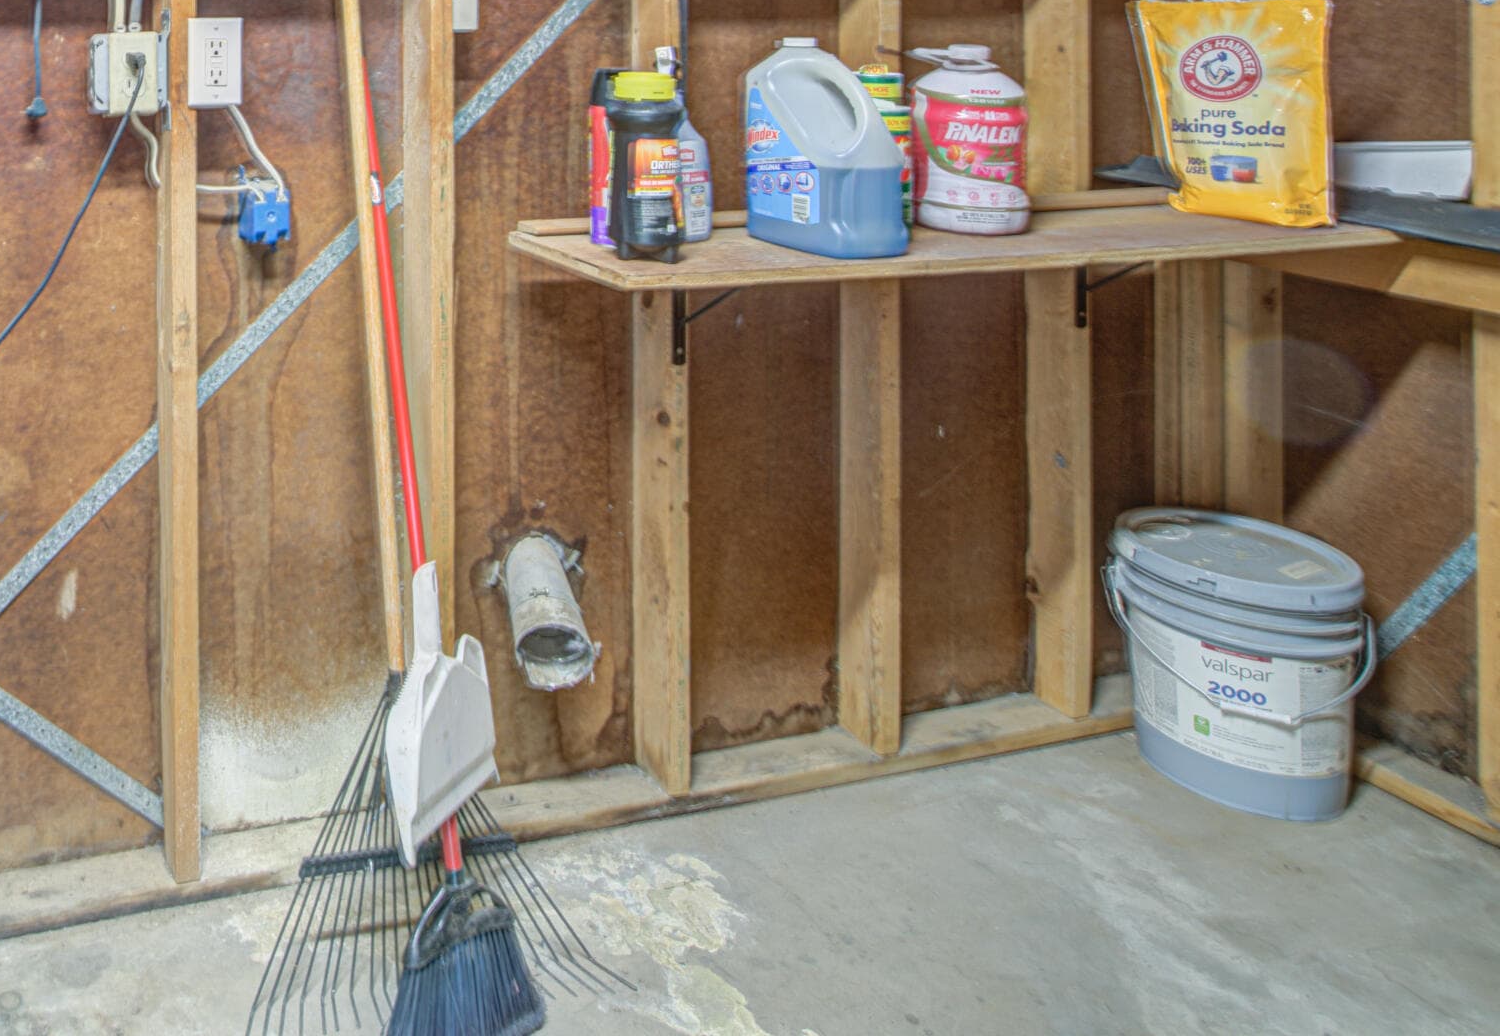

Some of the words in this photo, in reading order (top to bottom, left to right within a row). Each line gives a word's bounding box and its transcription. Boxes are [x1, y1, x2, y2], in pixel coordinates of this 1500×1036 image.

[1184, 48, 1203, 74] ARM
[1202, 42, 1213, 51] &
[1214, 39, 1257, 75] HAMMER
[1201, 109, 1236, 121] pure
[1231, 120, 1286, 136] Soda
[1185, 165, 1207, 175] USES
[1201, 655, 1275, 683] valspar
[1207, 680, 1267, 706] 2000
